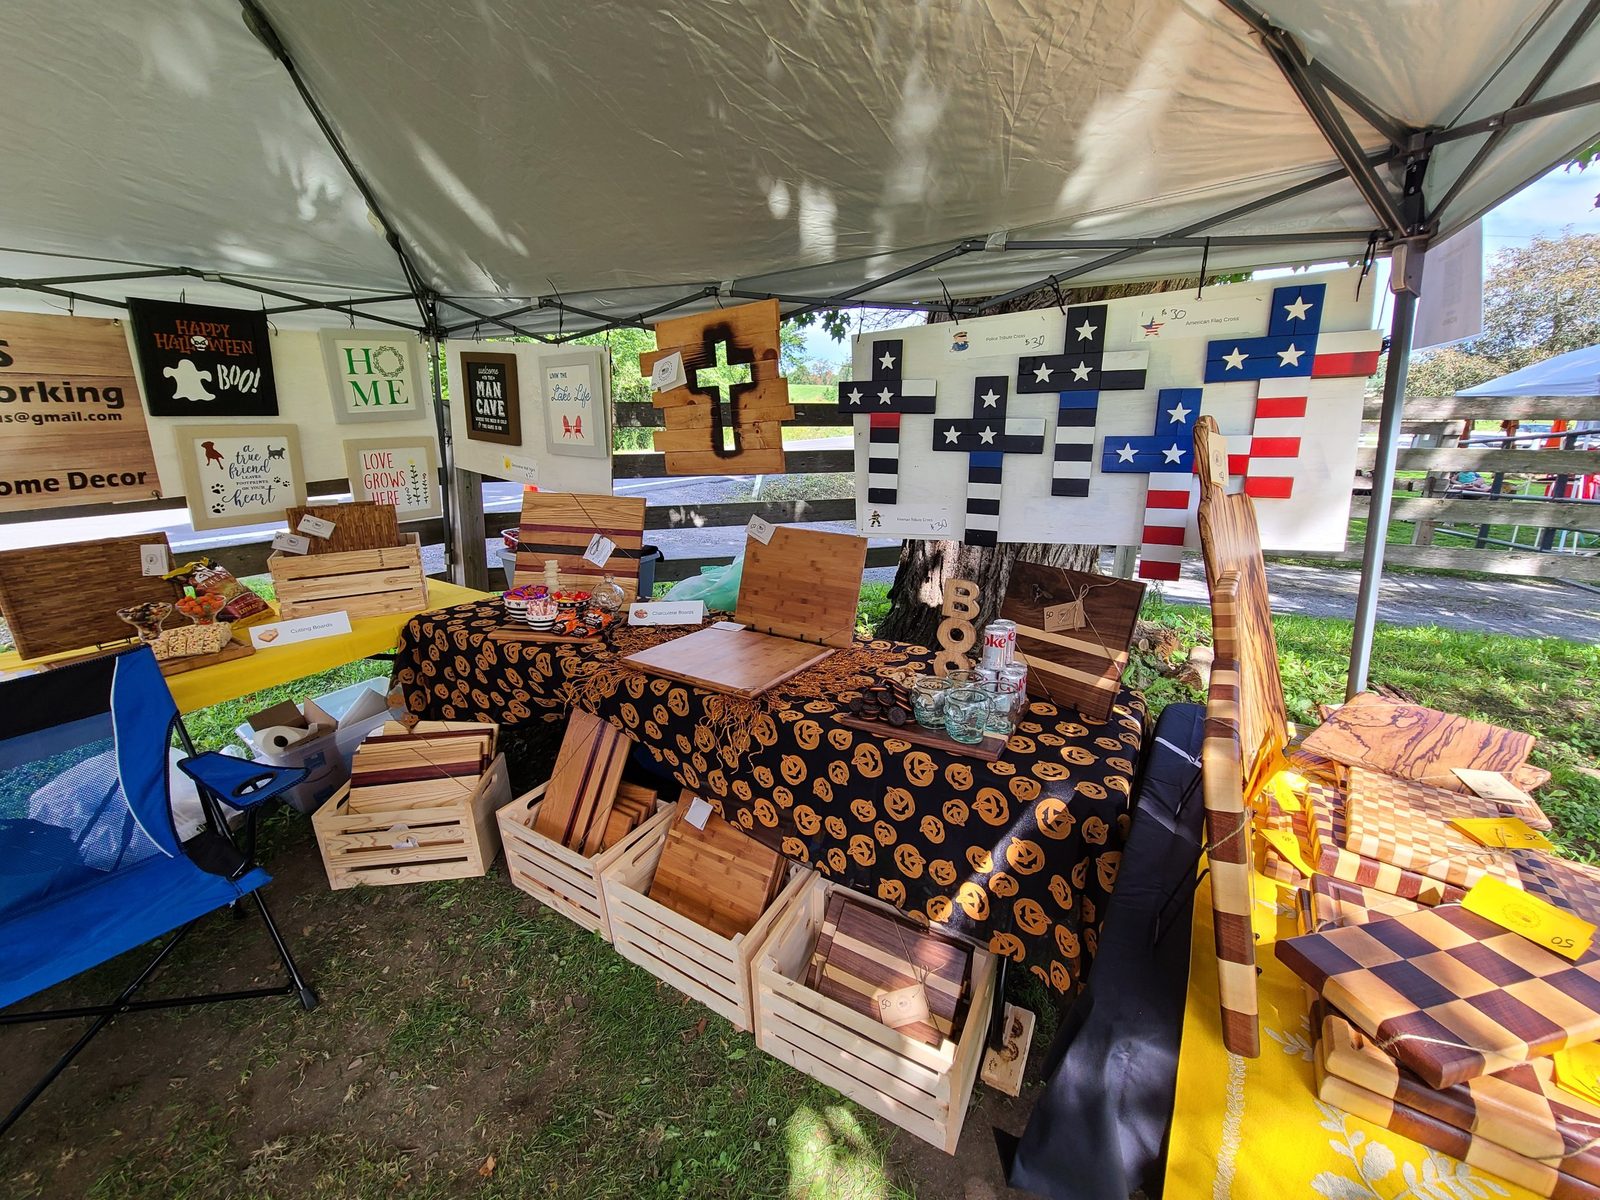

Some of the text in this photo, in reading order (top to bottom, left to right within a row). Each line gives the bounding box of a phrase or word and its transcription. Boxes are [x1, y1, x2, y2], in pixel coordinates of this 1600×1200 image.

[176, 319, 231, 337] HAPPY
[216, 363, 261, 394] BOO!
[348, 379, 409, 407] ME
[475, 380, 503, 399] MAN
[551, 383, 592, 409] Lake Life
[475, 398, 506, 417] CAVE
[0, 411, 122, 425] s@gmail.com
[236, 451, 261, 465] true
[363, 452, 394, 471] LOVE
[229, 458, 271, 480] friend
[67, 471, 147, 490] Decor
[364, 470, 406, 490] GROWS
[222, 485, 276, 508] heart
[290, 623, 333, 635] Cutting Boards
[983, 634, 1006, 649] oke
[881, 998, 892, 1010] 50
